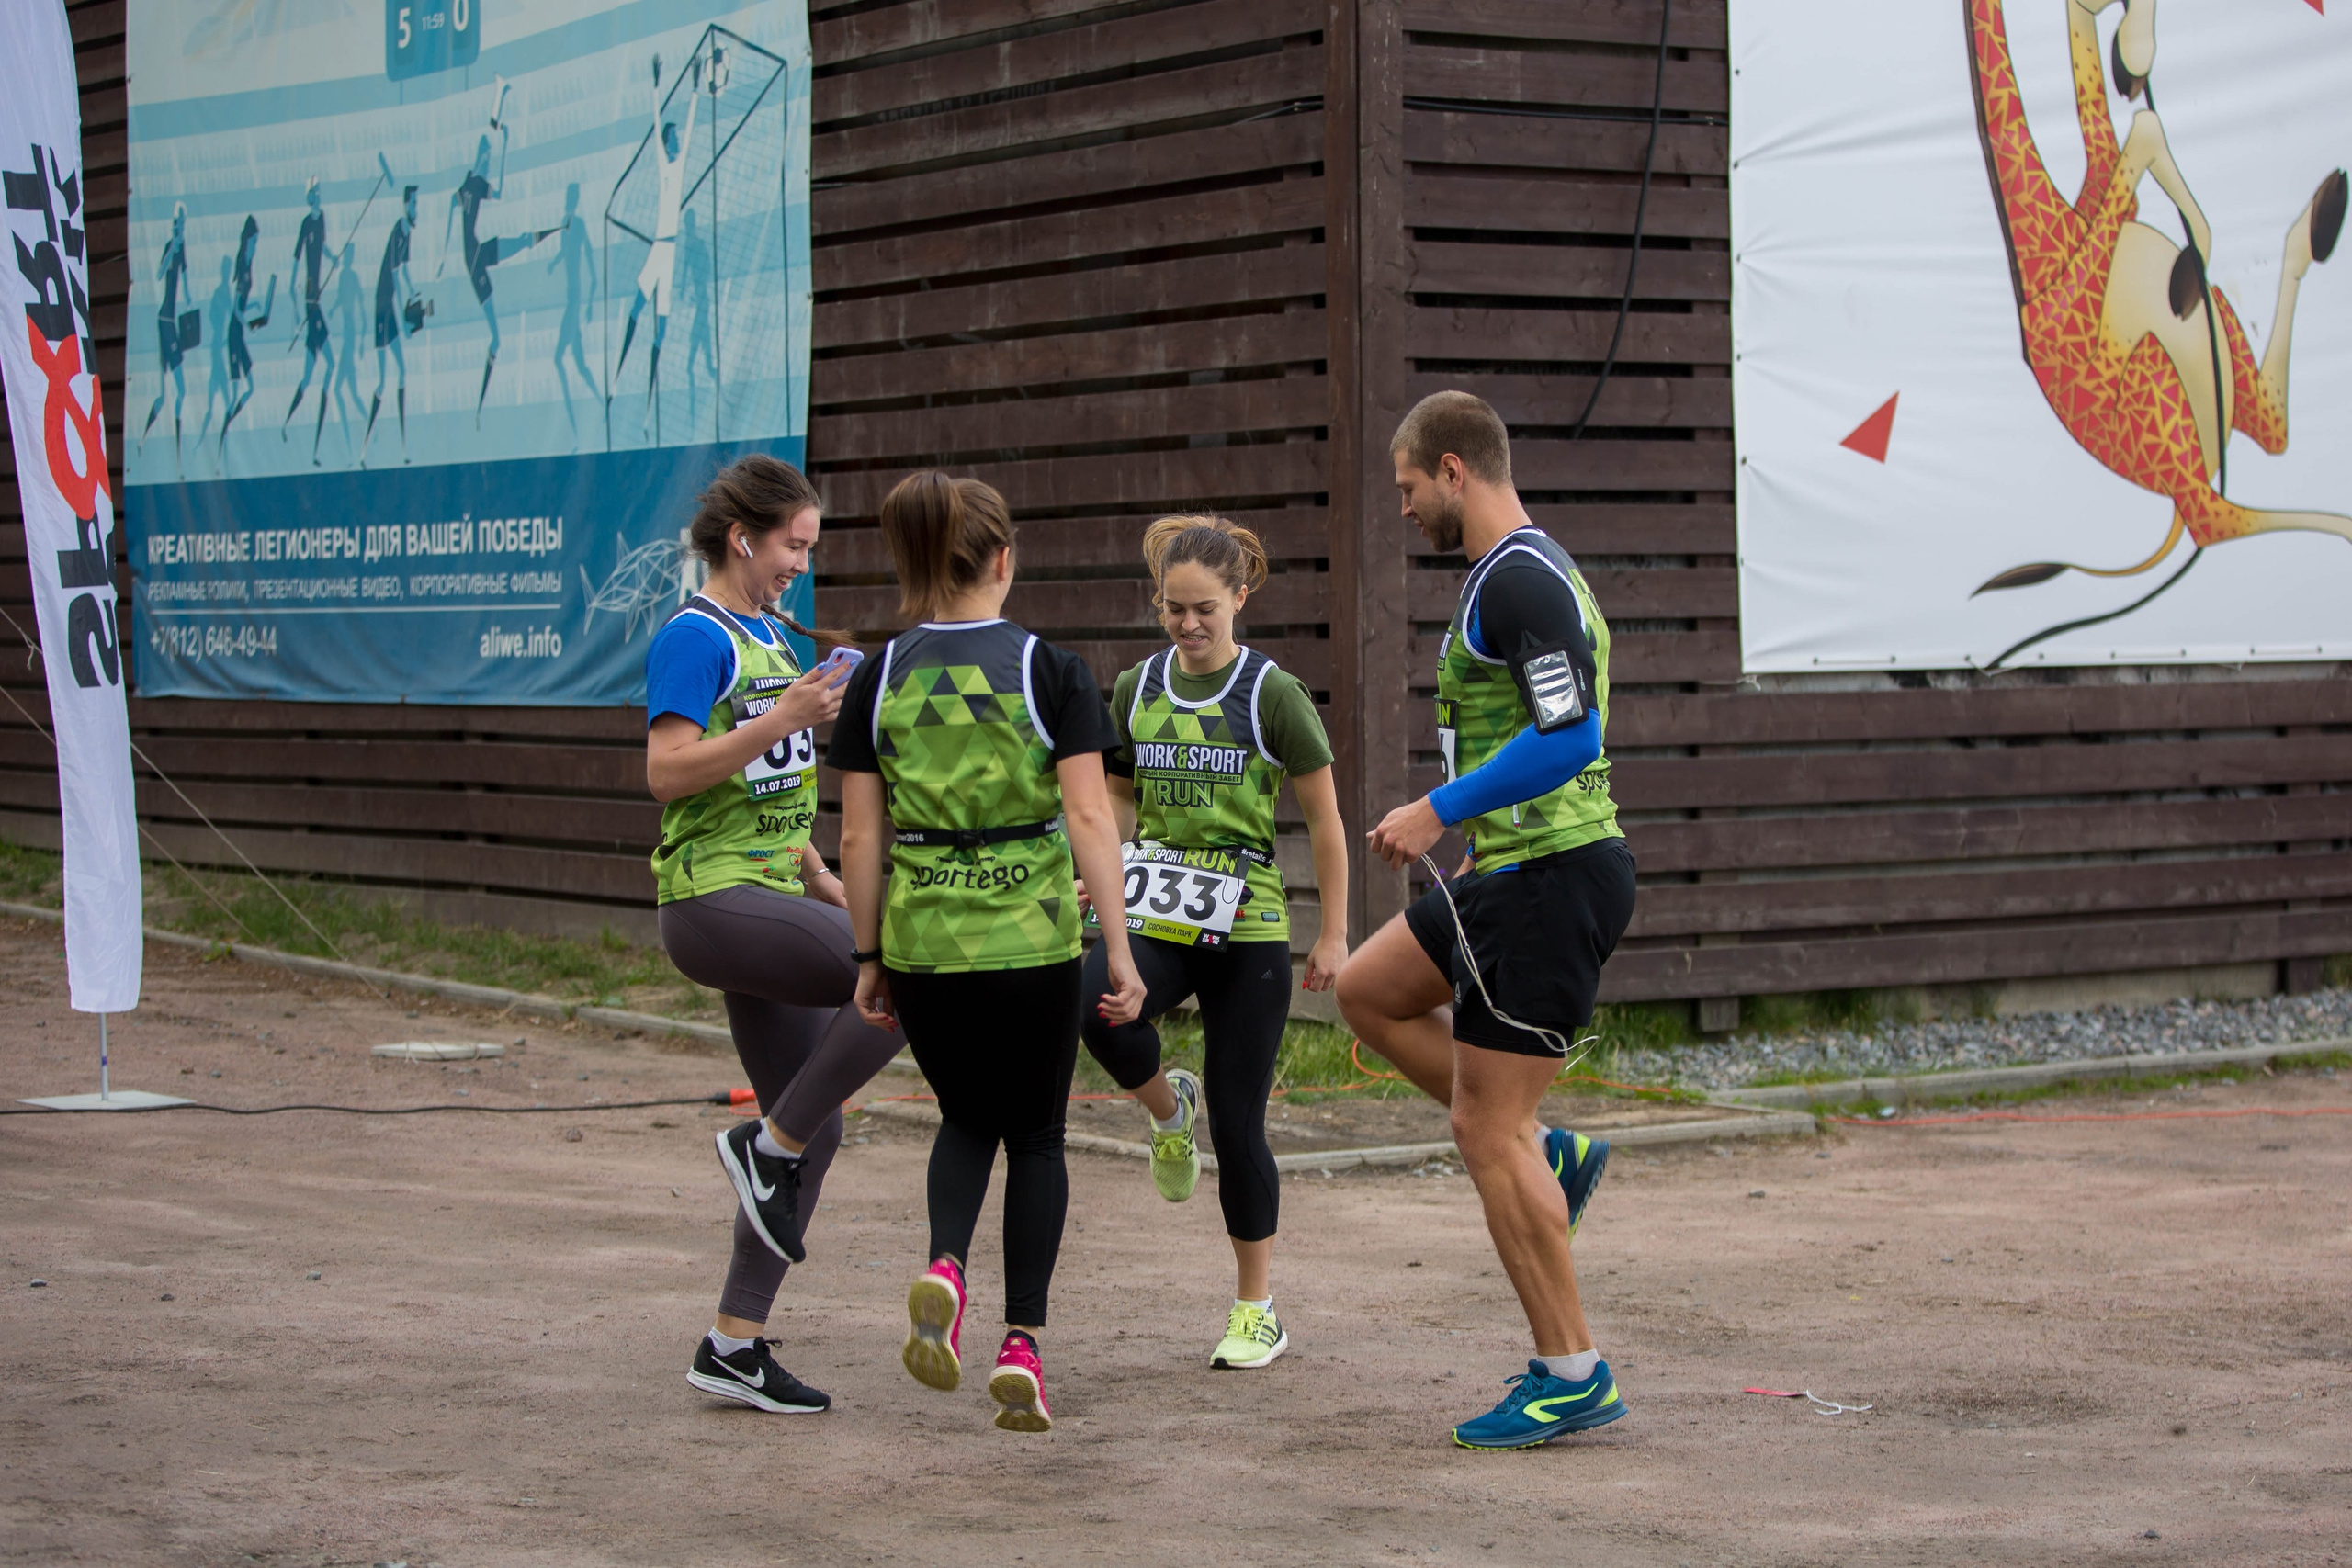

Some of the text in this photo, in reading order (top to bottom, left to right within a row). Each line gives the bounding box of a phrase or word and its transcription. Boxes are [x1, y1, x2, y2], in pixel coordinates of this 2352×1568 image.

[398, 7, 411, 49] 5
[453, 0, 469, 31] 0
[148, 513, 562, 565] КРЕАТИВНЫЕ ЛЕГИОНЕРЫ ДЛЯ ВАШЕЙ ПОБЕДЫ
[148, 580, 207, 602] РЕКЛАМНЫЕ
[253, 577, 358, 602] ПРЕЗЕНТАЦИОННЫЕ
[362, 575, 404, 602] ВИДЕО,
[410, 572, 508, 595] КОРПОРАТИВНЫЕ
[510, 570, 562, 593] ФИЛЬМЫ
[151, 625, 277, 663] +7(812) 646-49-44
[480, 625, 562, 658] aliwe.info
[1136, 743, 1247, 773] WORK&SPORT
[754, 775, 802, 795] 14.07.2019
[1159, 771, 1217, 781] КОРПОРАТИВНЫЙ
[1157, 780, 1212, 807] RUN
[748, 849, 775, 858] ФРОСТ
[1183, 848, 1238, 874] RUN
[1148, 922, 1193, 938] СОСНОВКА ПАРК
